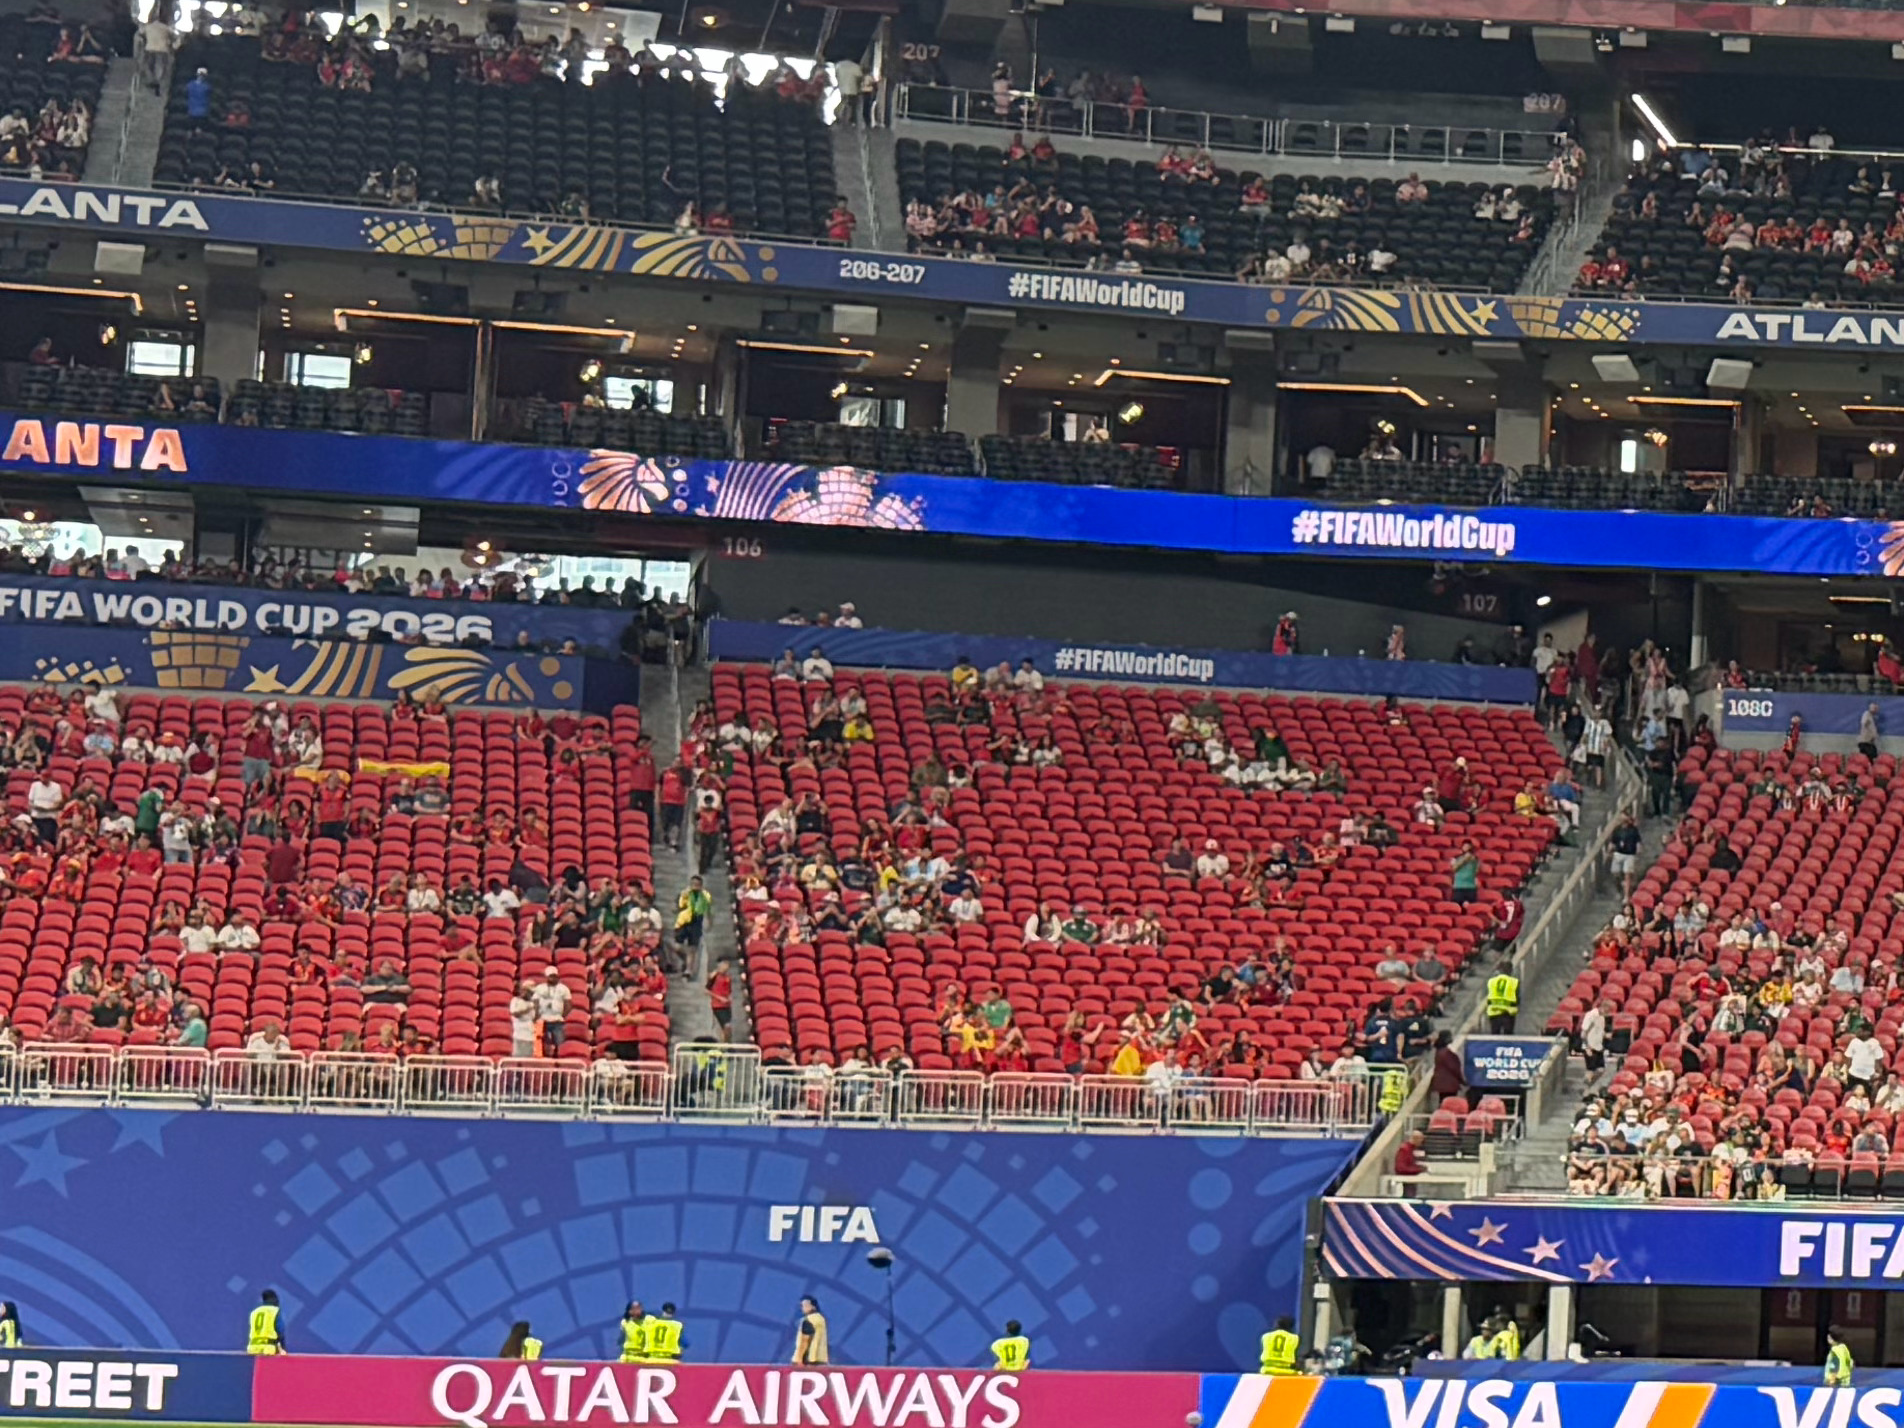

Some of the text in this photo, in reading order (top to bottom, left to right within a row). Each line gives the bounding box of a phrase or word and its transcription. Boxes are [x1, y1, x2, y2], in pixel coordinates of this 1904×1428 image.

[840, 260, 925, 283] 206-207
[1009, 273, 1184, 315] #FIFAWorldCup
[723, 537, 761, 557] 106
[1292, 511, 1515, 556] #FIFAWorldCup
[0, 588, 492, 645] FIFA WORLD CUP 2026
[1463, 594, 1497, 612] 107
[1056, 649, 1213, 681] #FIFAWorldCup
[1729, 700, 1772, 716] 108C
[1474, 1057, 1518, 1068] WORLD
[1496, 1047, 1522, 1057] FIFA
[769, 1206, 879, 1243] FIFA
[0, 1360, 178, 1410] REET
[431, 1363, 678, 1428] QATAR
